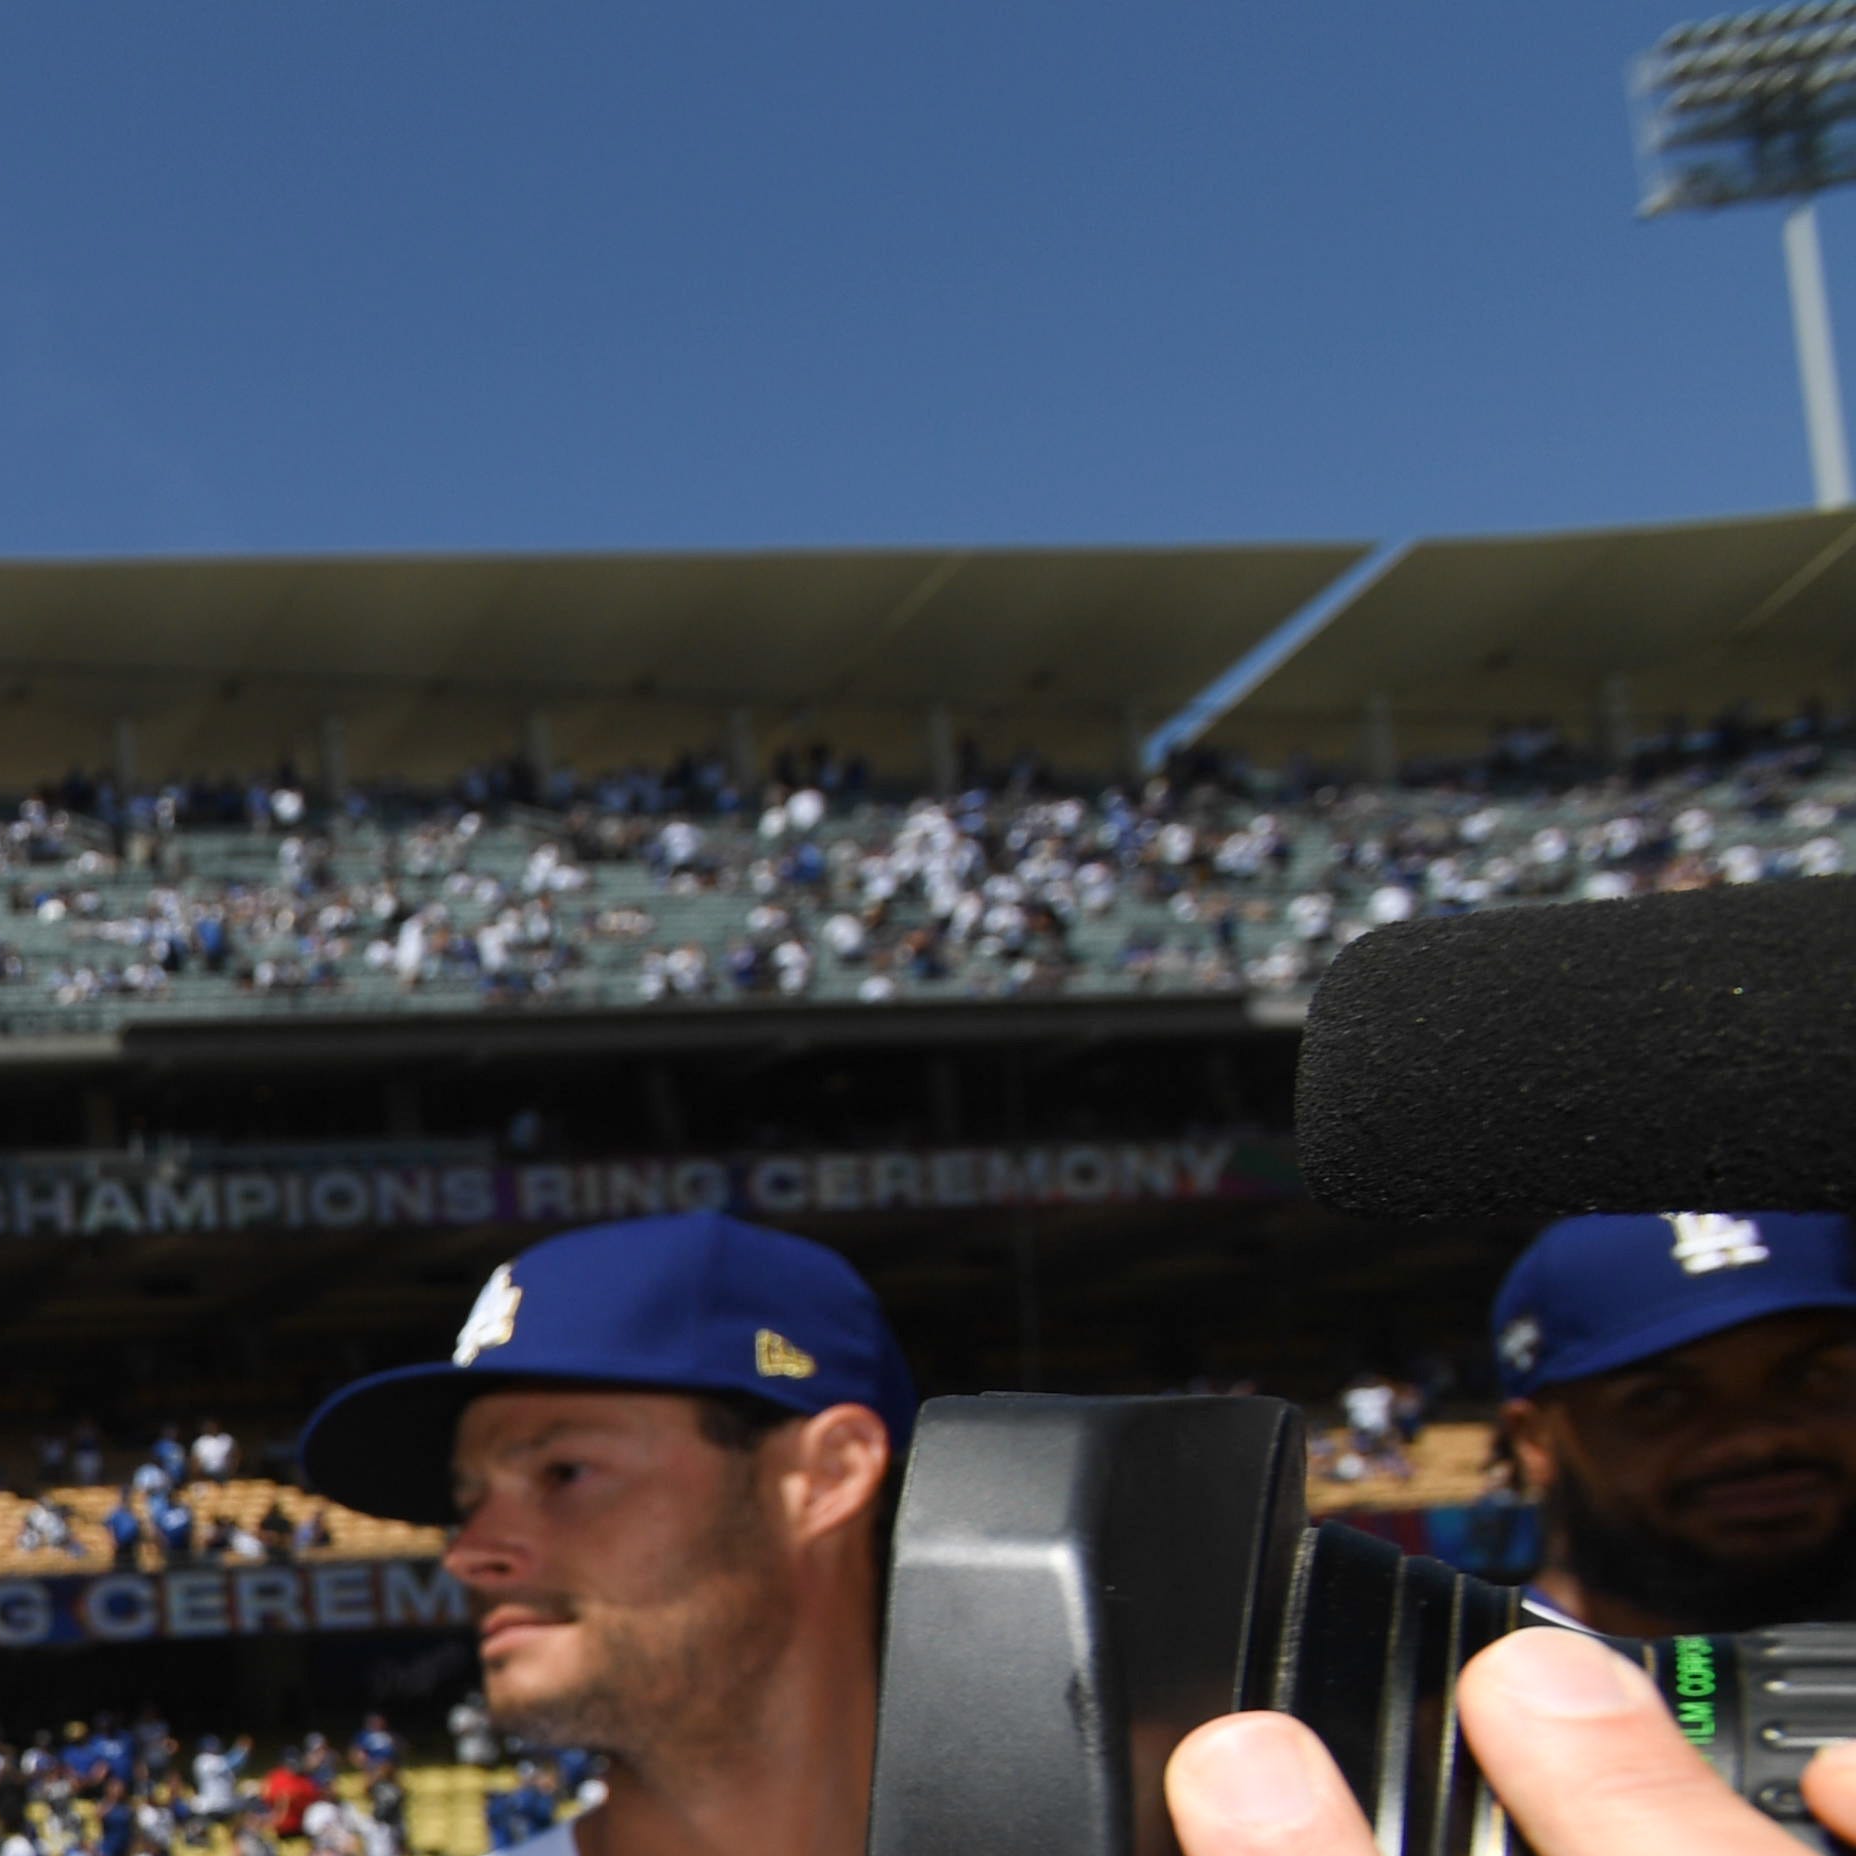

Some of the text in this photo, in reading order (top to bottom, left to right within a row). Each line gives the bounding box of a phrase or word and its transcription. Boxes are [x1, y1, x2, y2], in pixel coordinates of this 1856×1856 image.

[518, 1158, 732, 1222] RING
[746, 1139, 1232, 1212] CEREMONY
[84, 1558, 474, 1643] CEREM
[1676, 1701, 1718, 1764] ILM
